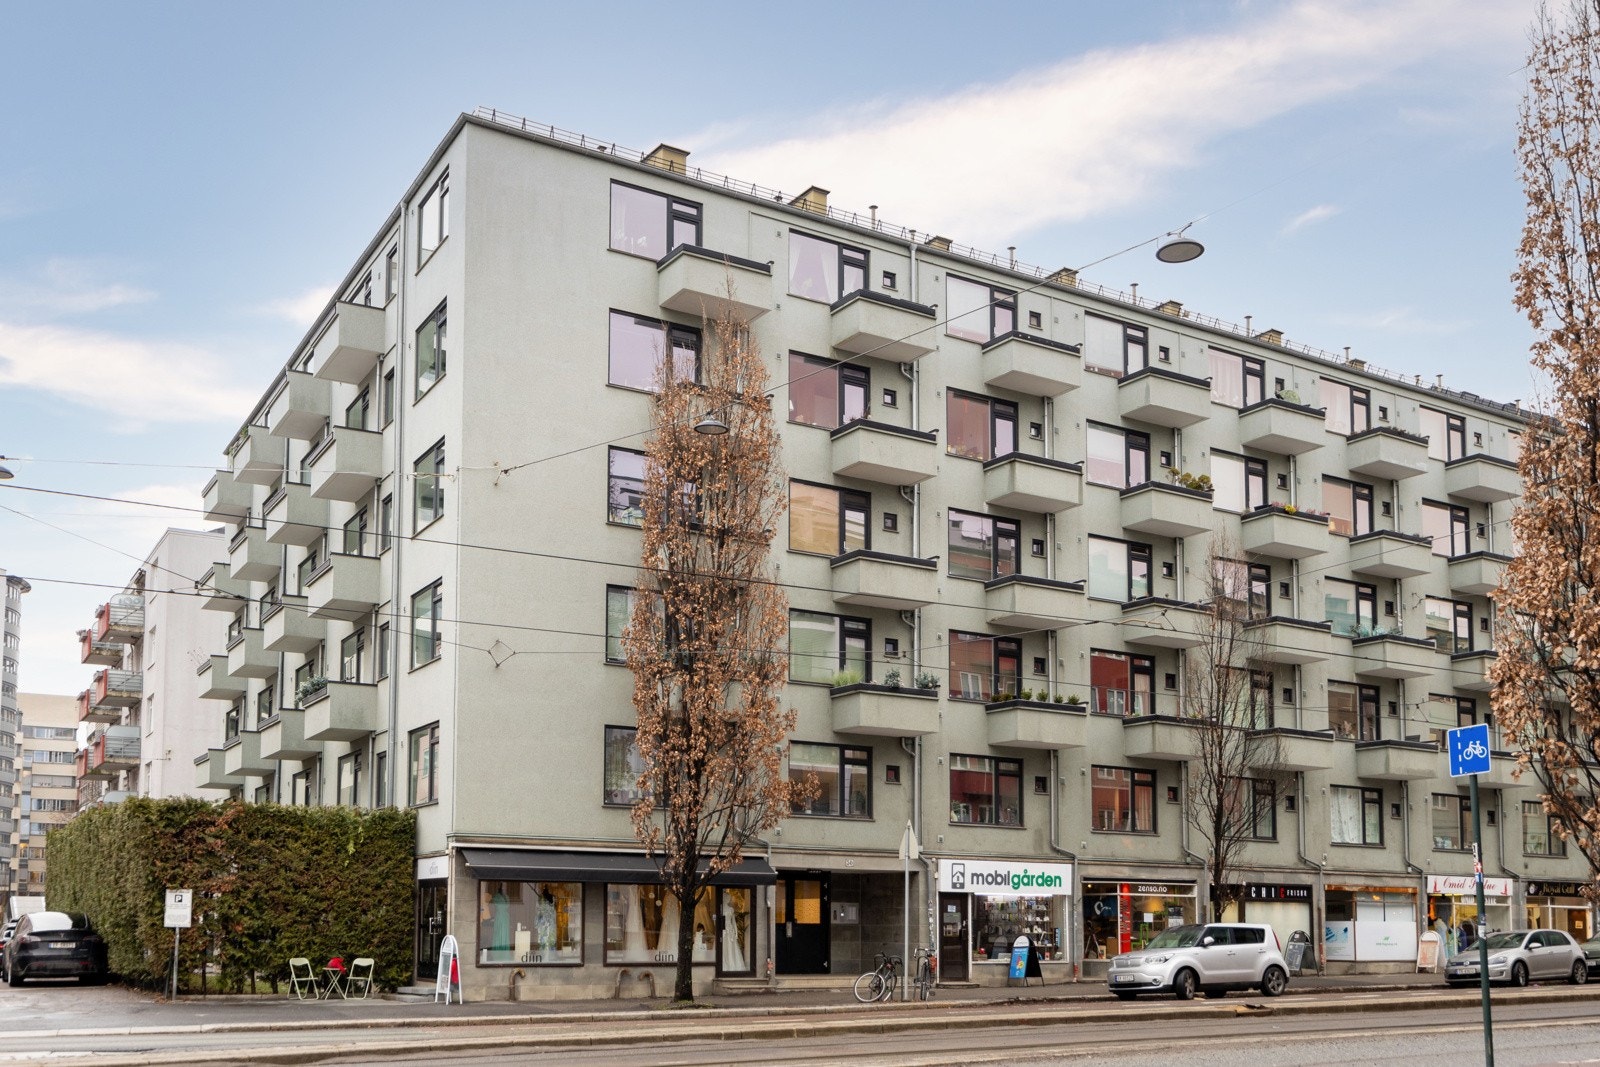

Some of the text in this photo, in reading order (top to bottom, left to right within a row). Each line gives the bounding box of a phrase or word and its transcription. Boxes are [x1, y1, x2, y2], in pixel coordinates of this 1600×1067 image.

[971, 869, 1062, 890] mobilgården
[520, 952, 542, 963] diin
[654, 951, 675, 962] diin
